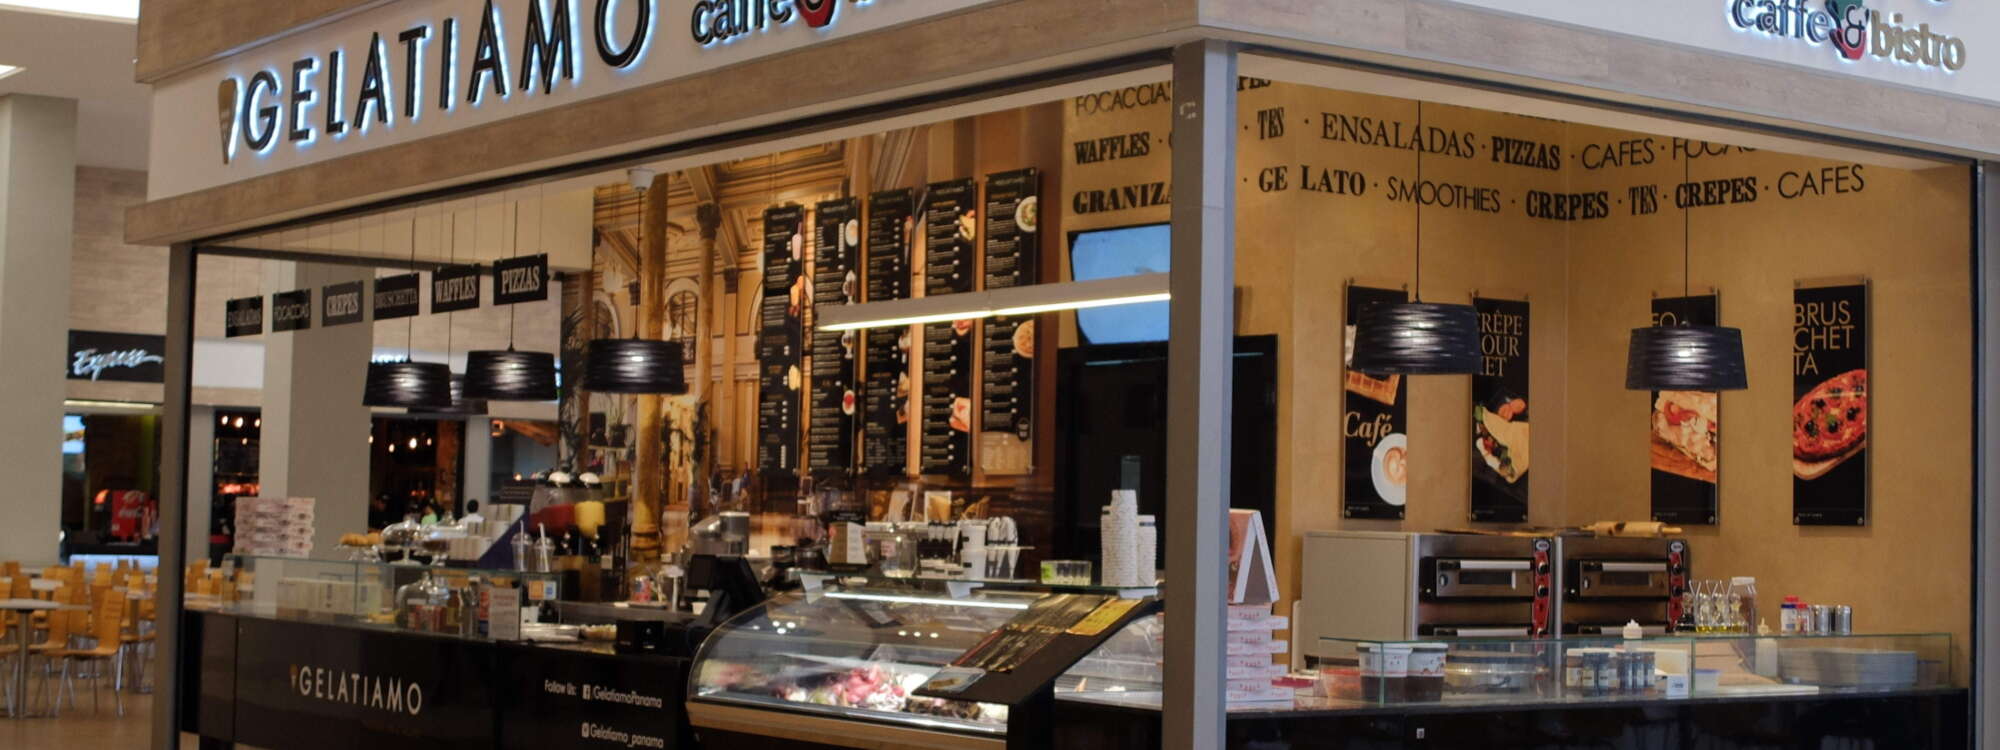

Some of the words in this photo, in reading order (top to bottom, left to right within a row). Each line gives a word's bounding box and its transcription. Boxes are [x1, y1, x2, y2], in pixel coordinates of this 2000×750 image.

[1871, 10, 1966, 71] bistro
[243, 0, 653, 151] GELATIAMO
[1075, 81, 1171, 115] FOCACCIA
[1074, 131, 1150, 164] WAFFLES
[1257, 106, 1285, 141] TES
[1321, 112, 1475, 159] ENSALADAS
[1491, 136, 1561, 171] PIZZAS
[1581, 138, 1655, 169] CAFES
[1073, 182, 1171, 214] GRANIZ
[1386, 176, 1501, 213] SMOOTHIES
[1525, 190, 1609, 222] CREPES
[1628, 185, 1658, 215] TES
[1675, 177, 1757, 209] CREPES
[1777, 164, 1865, 199] CAFES
[434, 275, 477, 304] WAFFLES
[500, 265, 541, 295] PIZZAS
[326, 292, 359, 317] CREPES
[1793, 300, 1850, 327] BRUS
[1477, 309, 1523, 336] RÊPE
[1481, 334, 1519, 357] OUR
[1792, 325, 1854, 351] CHET
[1343, 411, 1393, 447] Café
[299, 665, 423, 715] GELATIAMO
[544, 680, 566, 694] Follow
[593, 685, 662, 708] GelatiamoPanama
